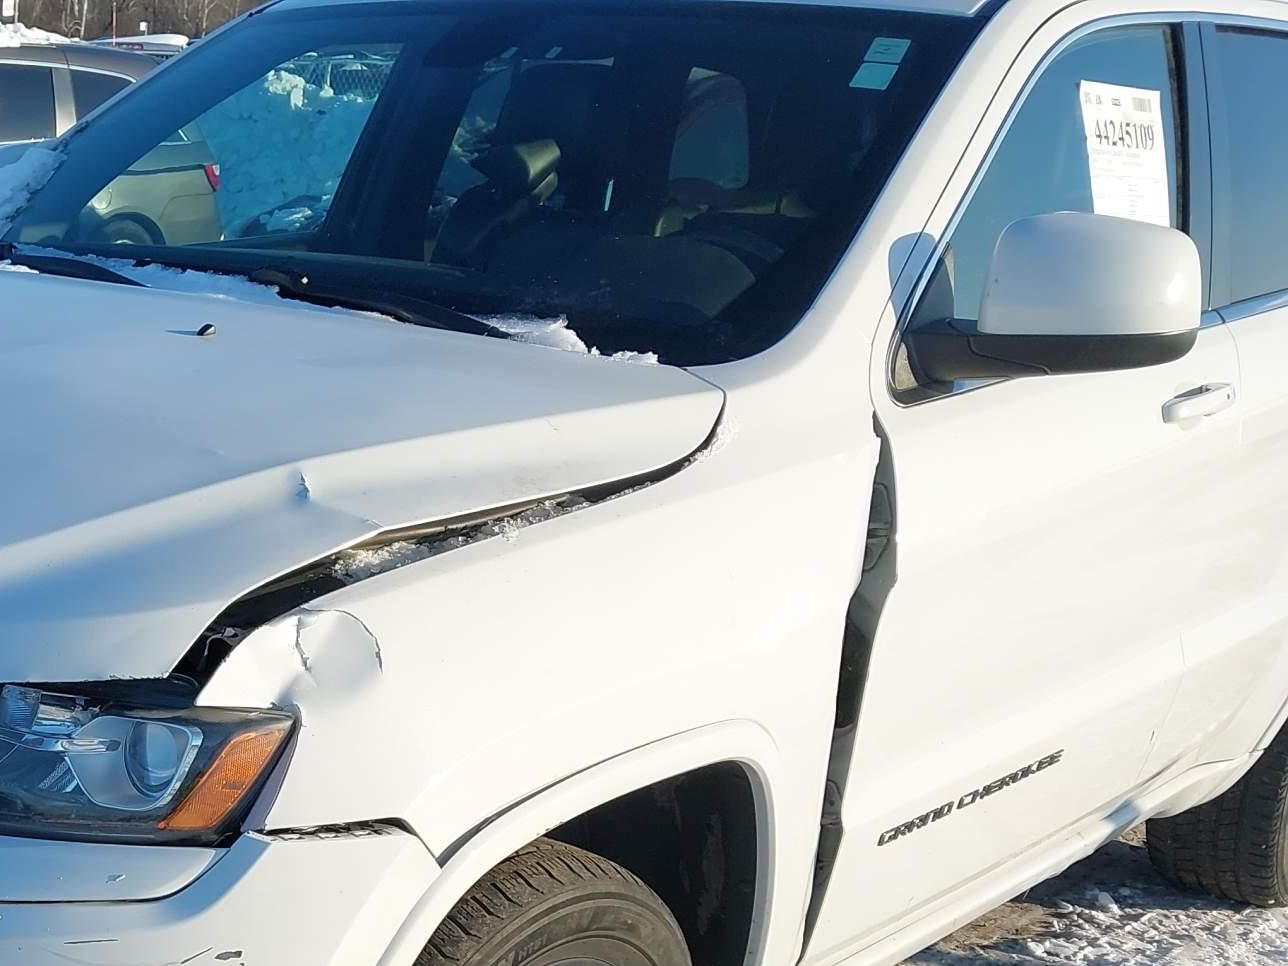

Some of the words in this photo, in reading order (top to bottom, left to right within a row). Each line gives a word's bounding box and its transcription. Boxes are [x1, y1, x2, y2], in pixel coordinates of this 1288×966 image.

[1094, 118, 1155, 151] 44245109
[877, 800, 955, 847] GRAND
[956, 748, 1065, 810] CHEROKEE
